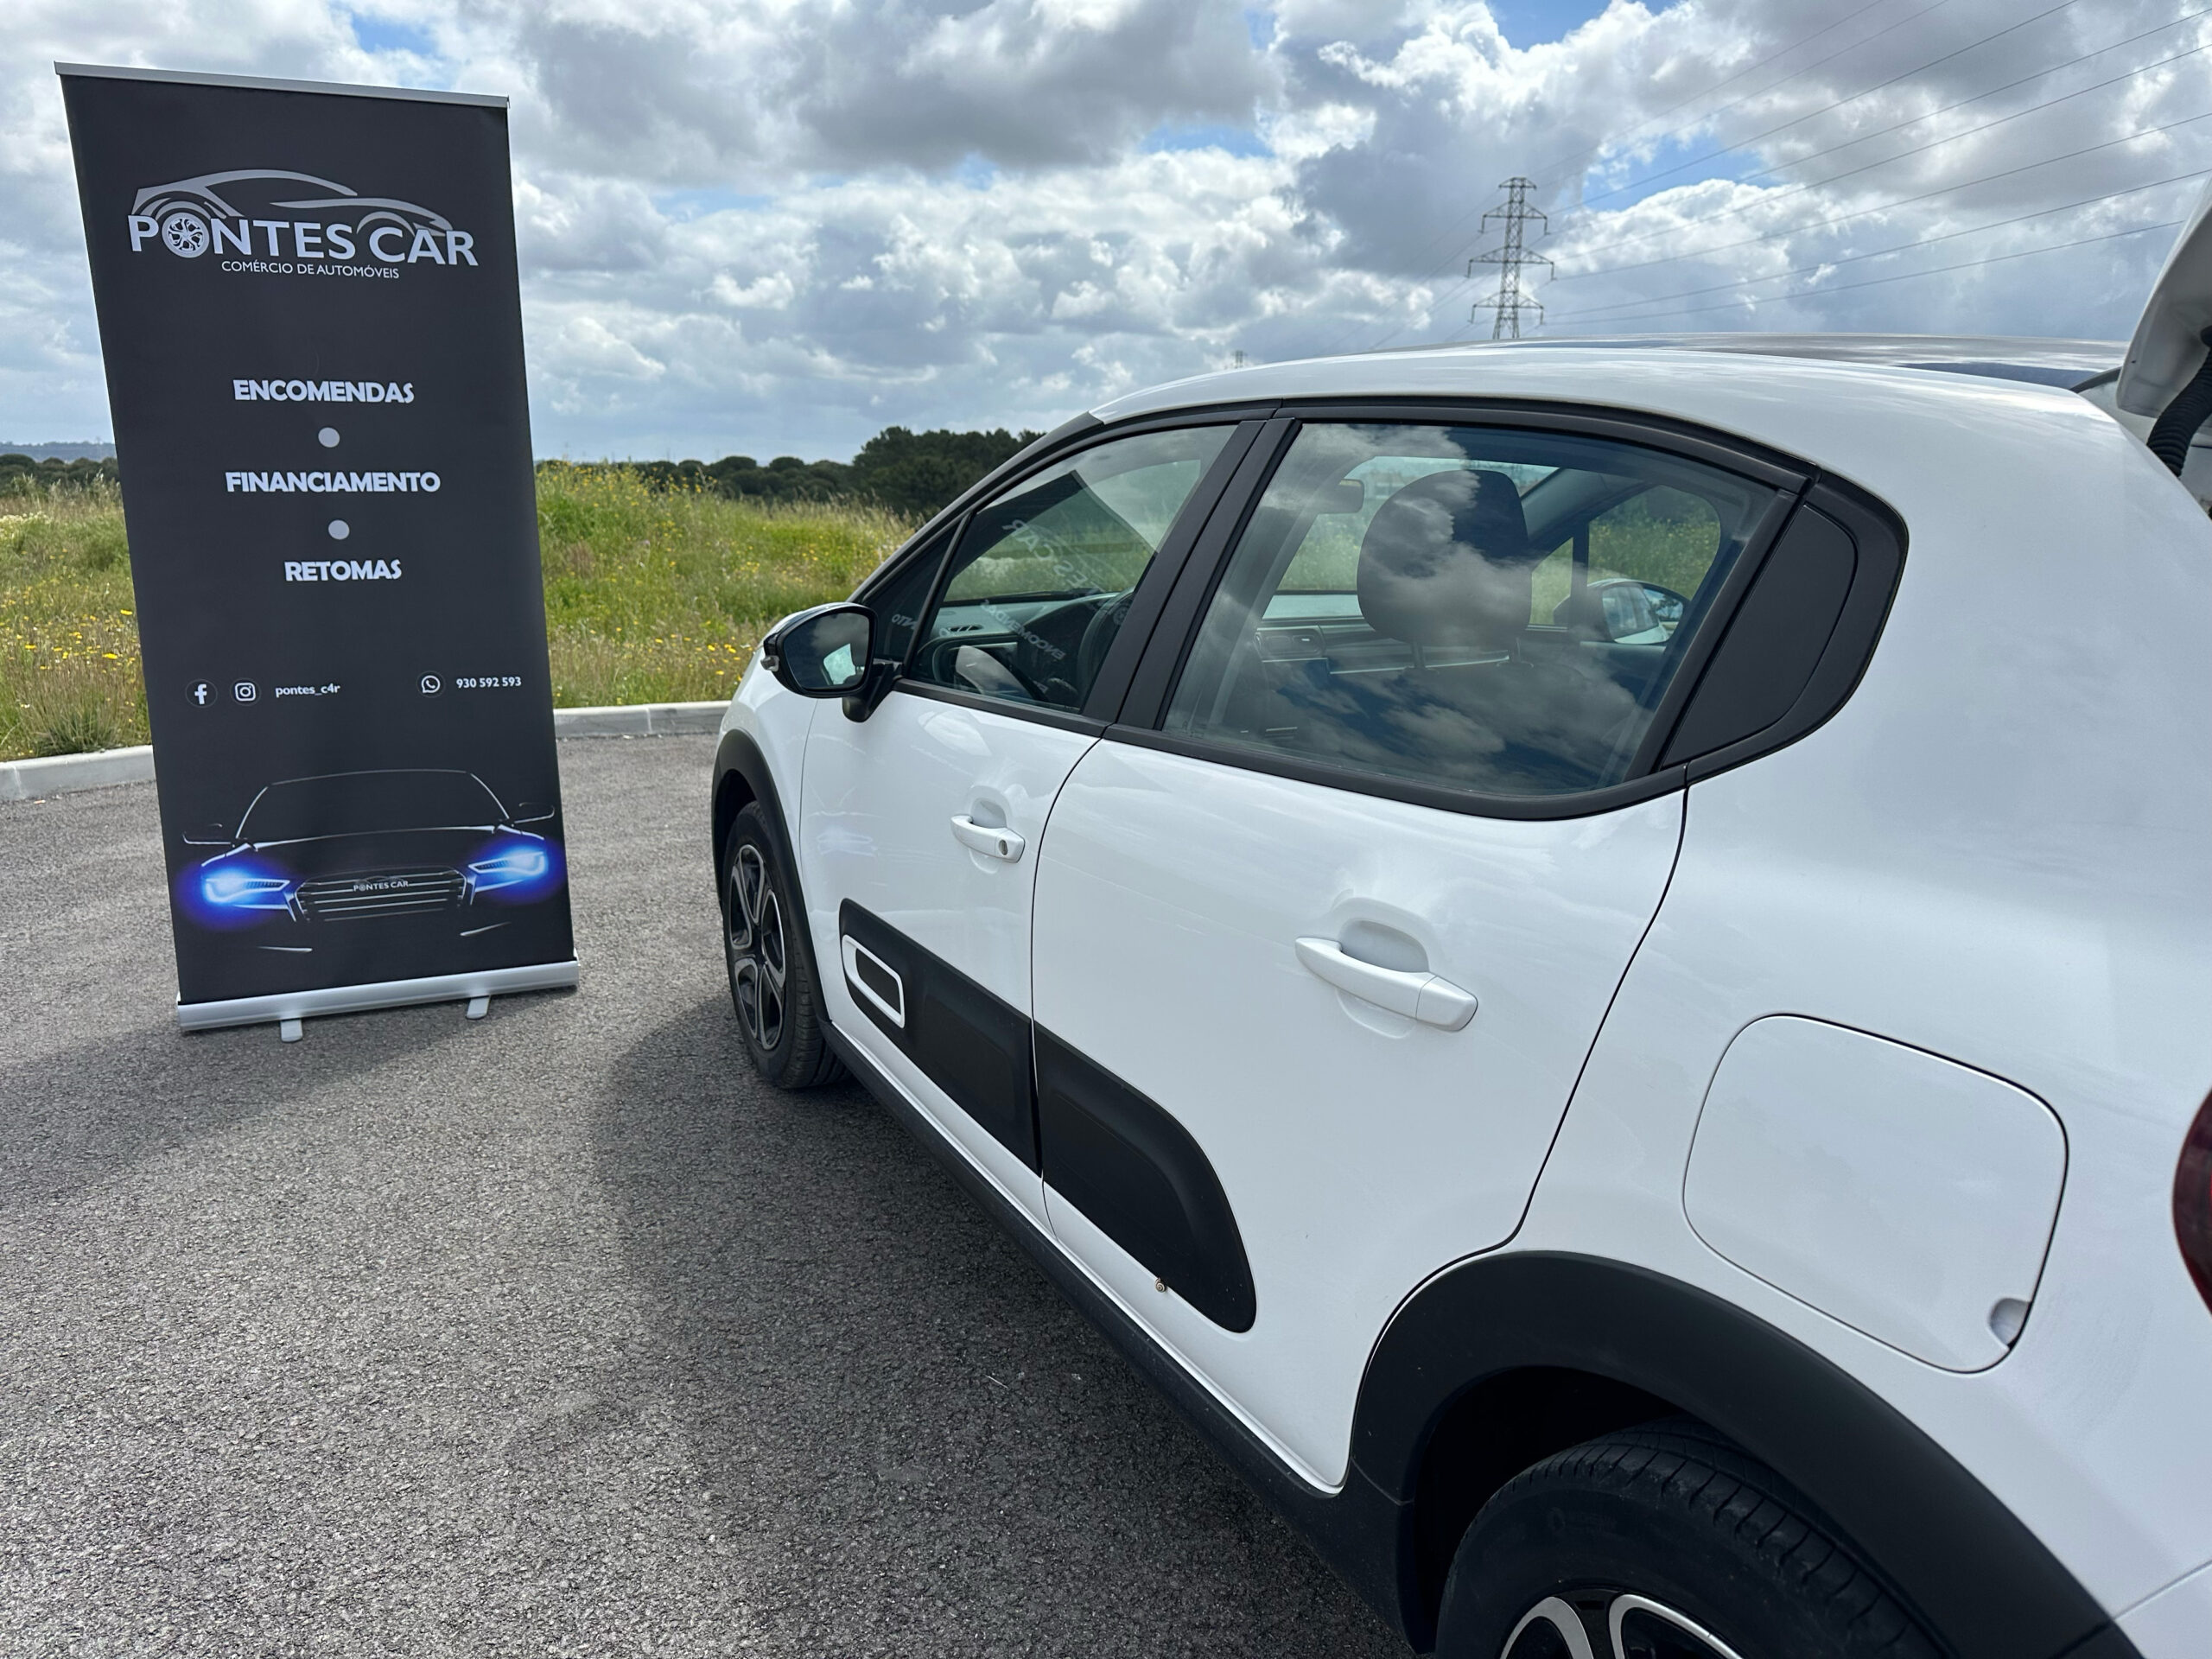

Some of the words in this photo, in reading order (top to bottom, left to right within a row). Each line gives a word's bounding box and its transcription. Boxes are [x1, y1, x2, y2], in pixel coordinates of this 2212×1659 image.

[128, 213, 356, 259] PONTES
[369, 227, 478, 265] CAR
[221, 259, 294, 274] COMÉRCIO
[297, 264, 315, 275] DE
[317, 264, 400, 278] AUTOMÓVEIS
[232, 379, 415, 404] ENCOMENDAS
[226, 472, 441, 493] FINANCIAMENTO
[284, 559, 403, 582] RETOMAS
[275, 683, 340, 698] pontes_c4r
[456, 677, 477, 689] 930
[479, 677, 499, 688] 592
[502, 676, 522, 687] 593
[391, 880, 409, 889] CAR
